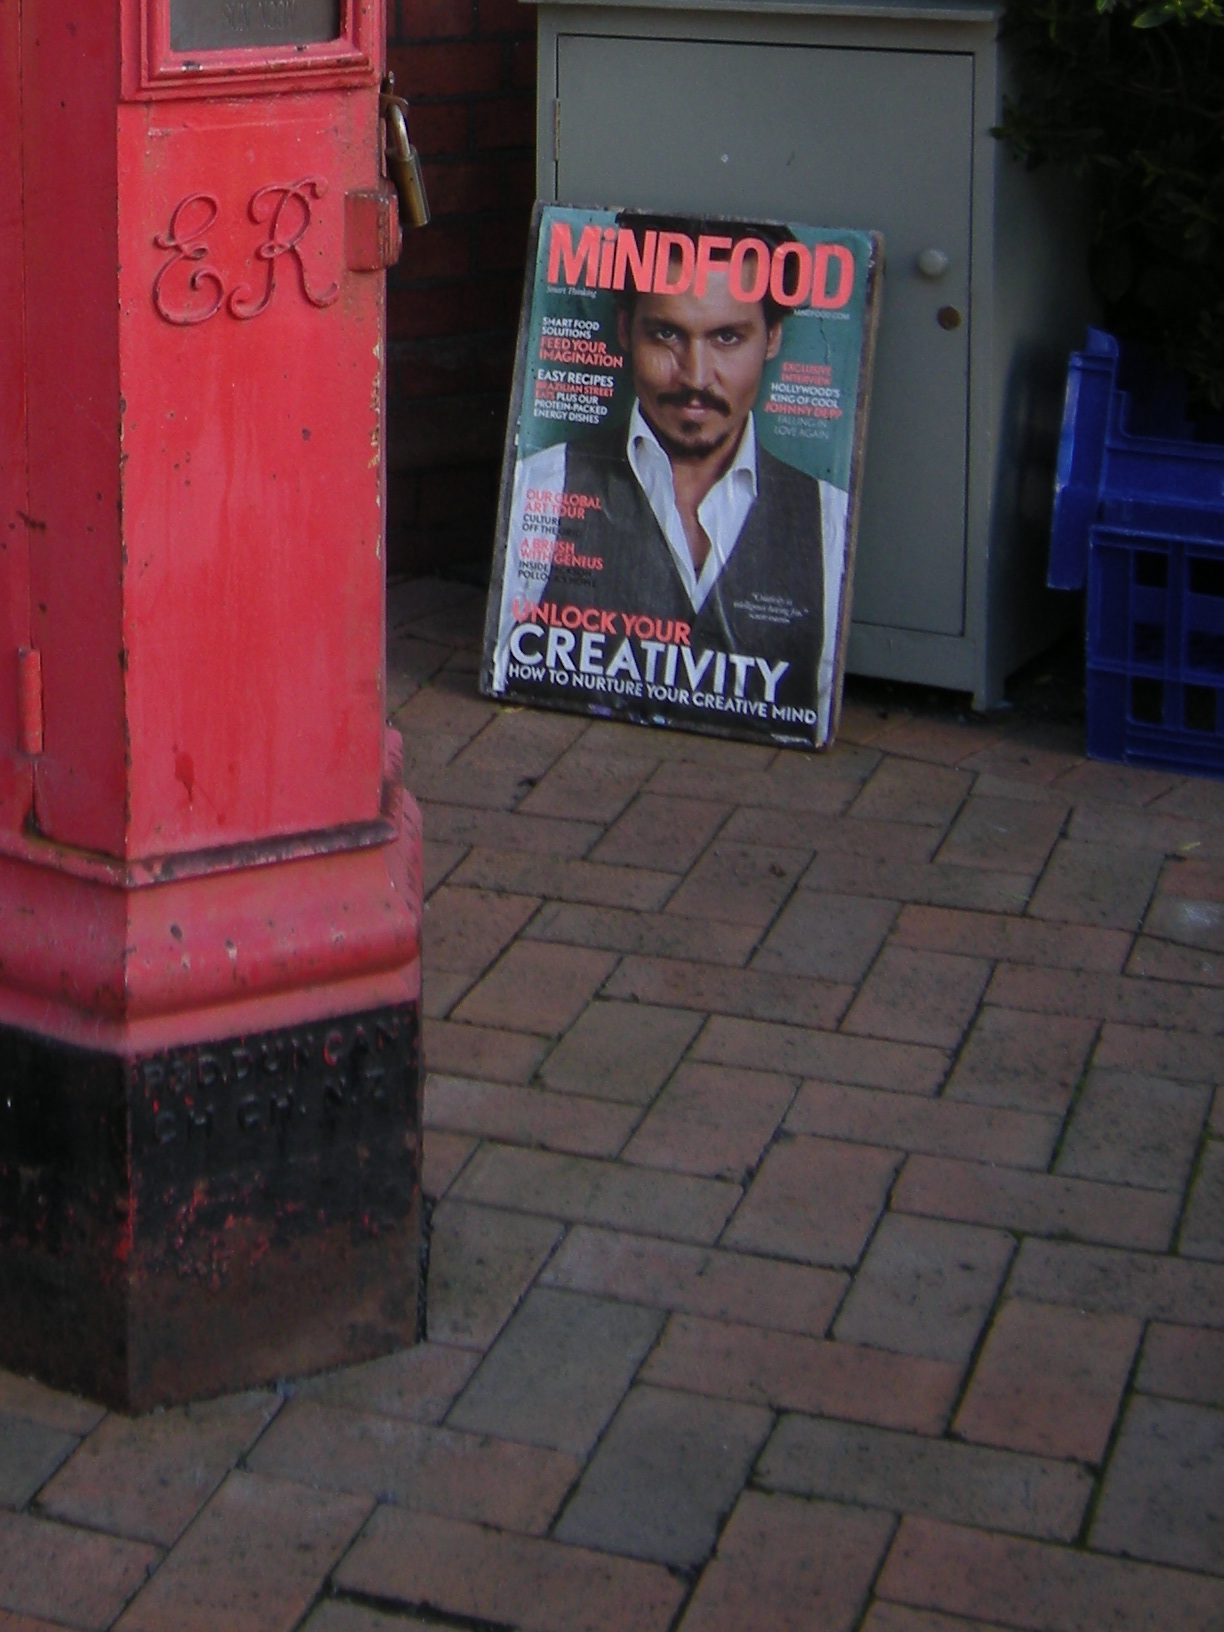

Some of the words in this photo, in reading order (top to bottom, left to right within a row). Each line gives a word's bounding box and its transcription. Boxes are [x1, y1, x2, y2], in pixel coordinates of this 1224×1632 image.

[568, 288, 597, 299] Thinking
[542, 317, 573, 328] SMART
[573, 319, 600, 331] FOOD
[541, 326, 592, 340] SOLUTIONS
[540, 337, 570, 351] FEED
[572, 339, 607, 355] YOUR
[539, 349, 623, 368] IMAGINATION
[537, 368, 567, 383] EASY
[568, 371, 614, 387] RECIPES
[583, 385, 614, 397] STREET
[771, 382, 841, 398] HOLLYWOOD'S
[556, 392, 578, 403] PLUS
[578, 393, 600, 405] OUR
[770, 393, 796, 404] KING
[796, 395, 812, 406] OF
[812, 397, 840, 408] COOL
[534, 399, 608, 416] PROTEIN-PACKED
[533, 408, 569, 421] ENERGY
[569, 411, 600, 424] DISHES
[554, 492, 602, 510] GLOBAL
[551, 503, 585, 519] TOUR
[553, 552, 604, 570] GENIUS
[512, 599, 617, 635] UNLOCK
[621, 613, 691, 645] YOUR
[509, 625, 790, 704] CREATIVITY
[508, 663, 545, 682] HOW
[549, 670, 569, 685] TO
[571, 672, 644, 698] NURTURE
[646, 683, 691, 705] YOUR
[692, 691, 768, 718] CREATIVE
[771, 706, 818, 726] MIND
